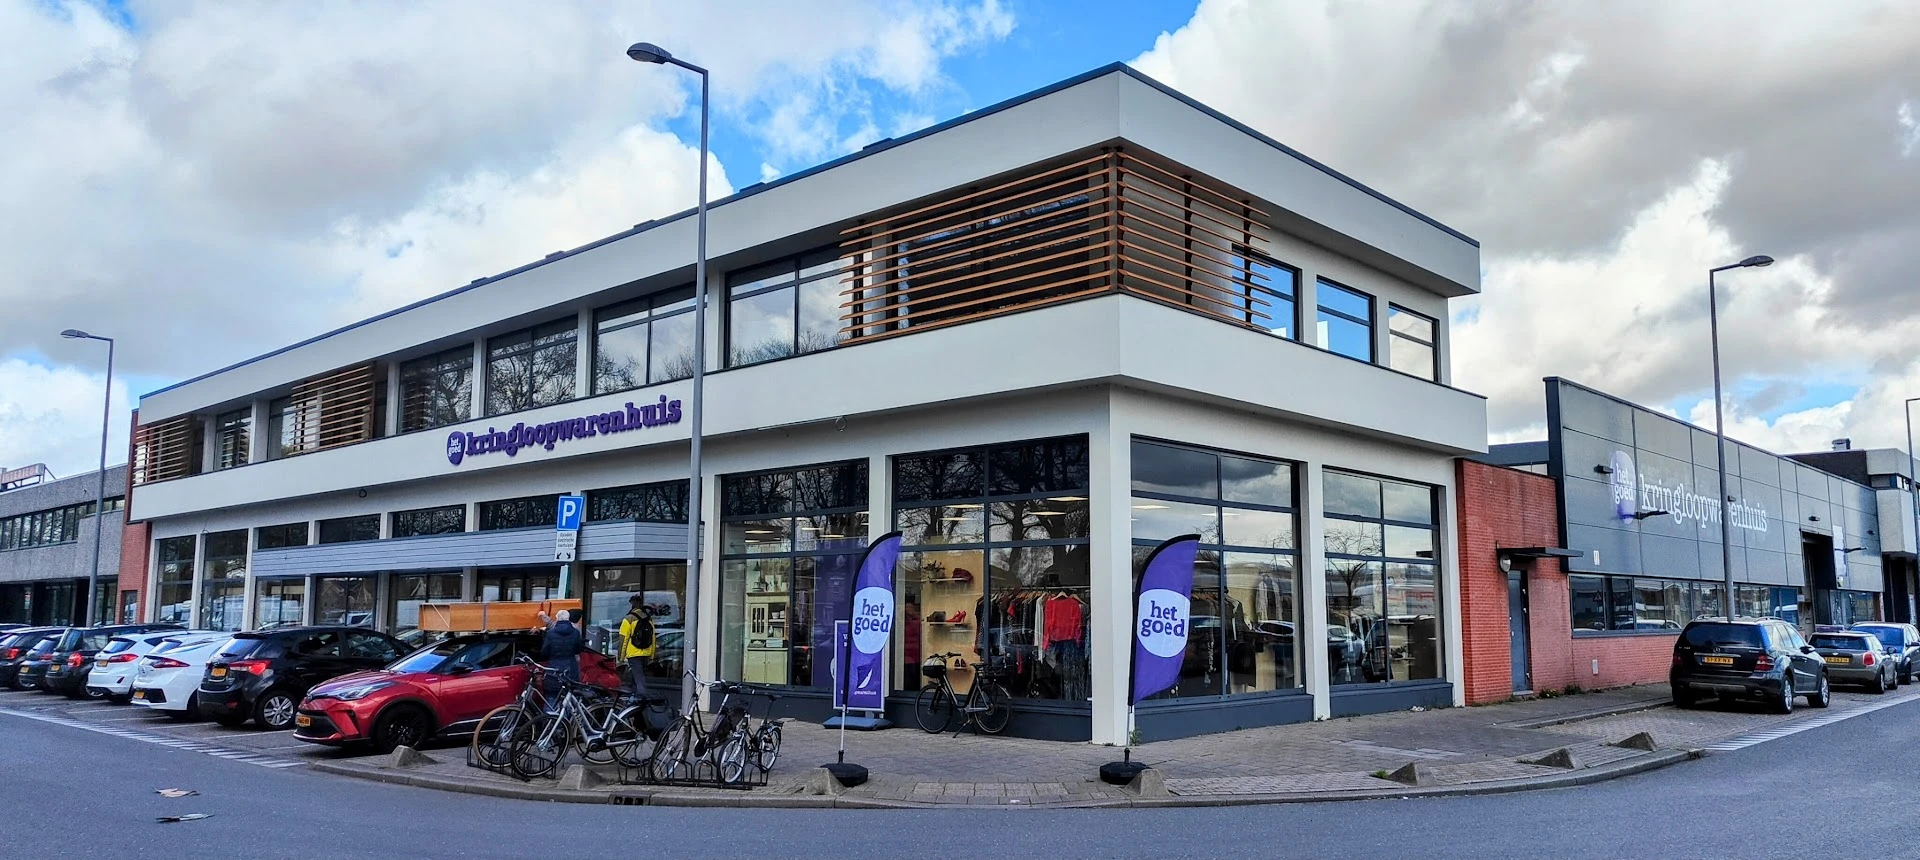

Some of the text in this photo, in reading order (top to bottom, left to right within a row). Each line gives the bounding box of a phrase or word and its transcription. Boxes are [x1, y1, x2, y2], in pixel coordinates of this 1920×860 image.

[465, 394, 682, 456] kringloopwarenhuis
[448, 443, 461, 457] goed
[450, 437, 460, 447] het
[1615, 463, 1630, 484] het
[1613, 481, 1634, 504] goed
[1639, 473, 1768, 532] kringloopwenhuis
[562, 500, 576, 527] P
[862, 599, 885, 618] het
[1150, 600, 1178, 621] het
[854, 615, 890, 635] goed
[1141, 618, 1185, 637] goed
